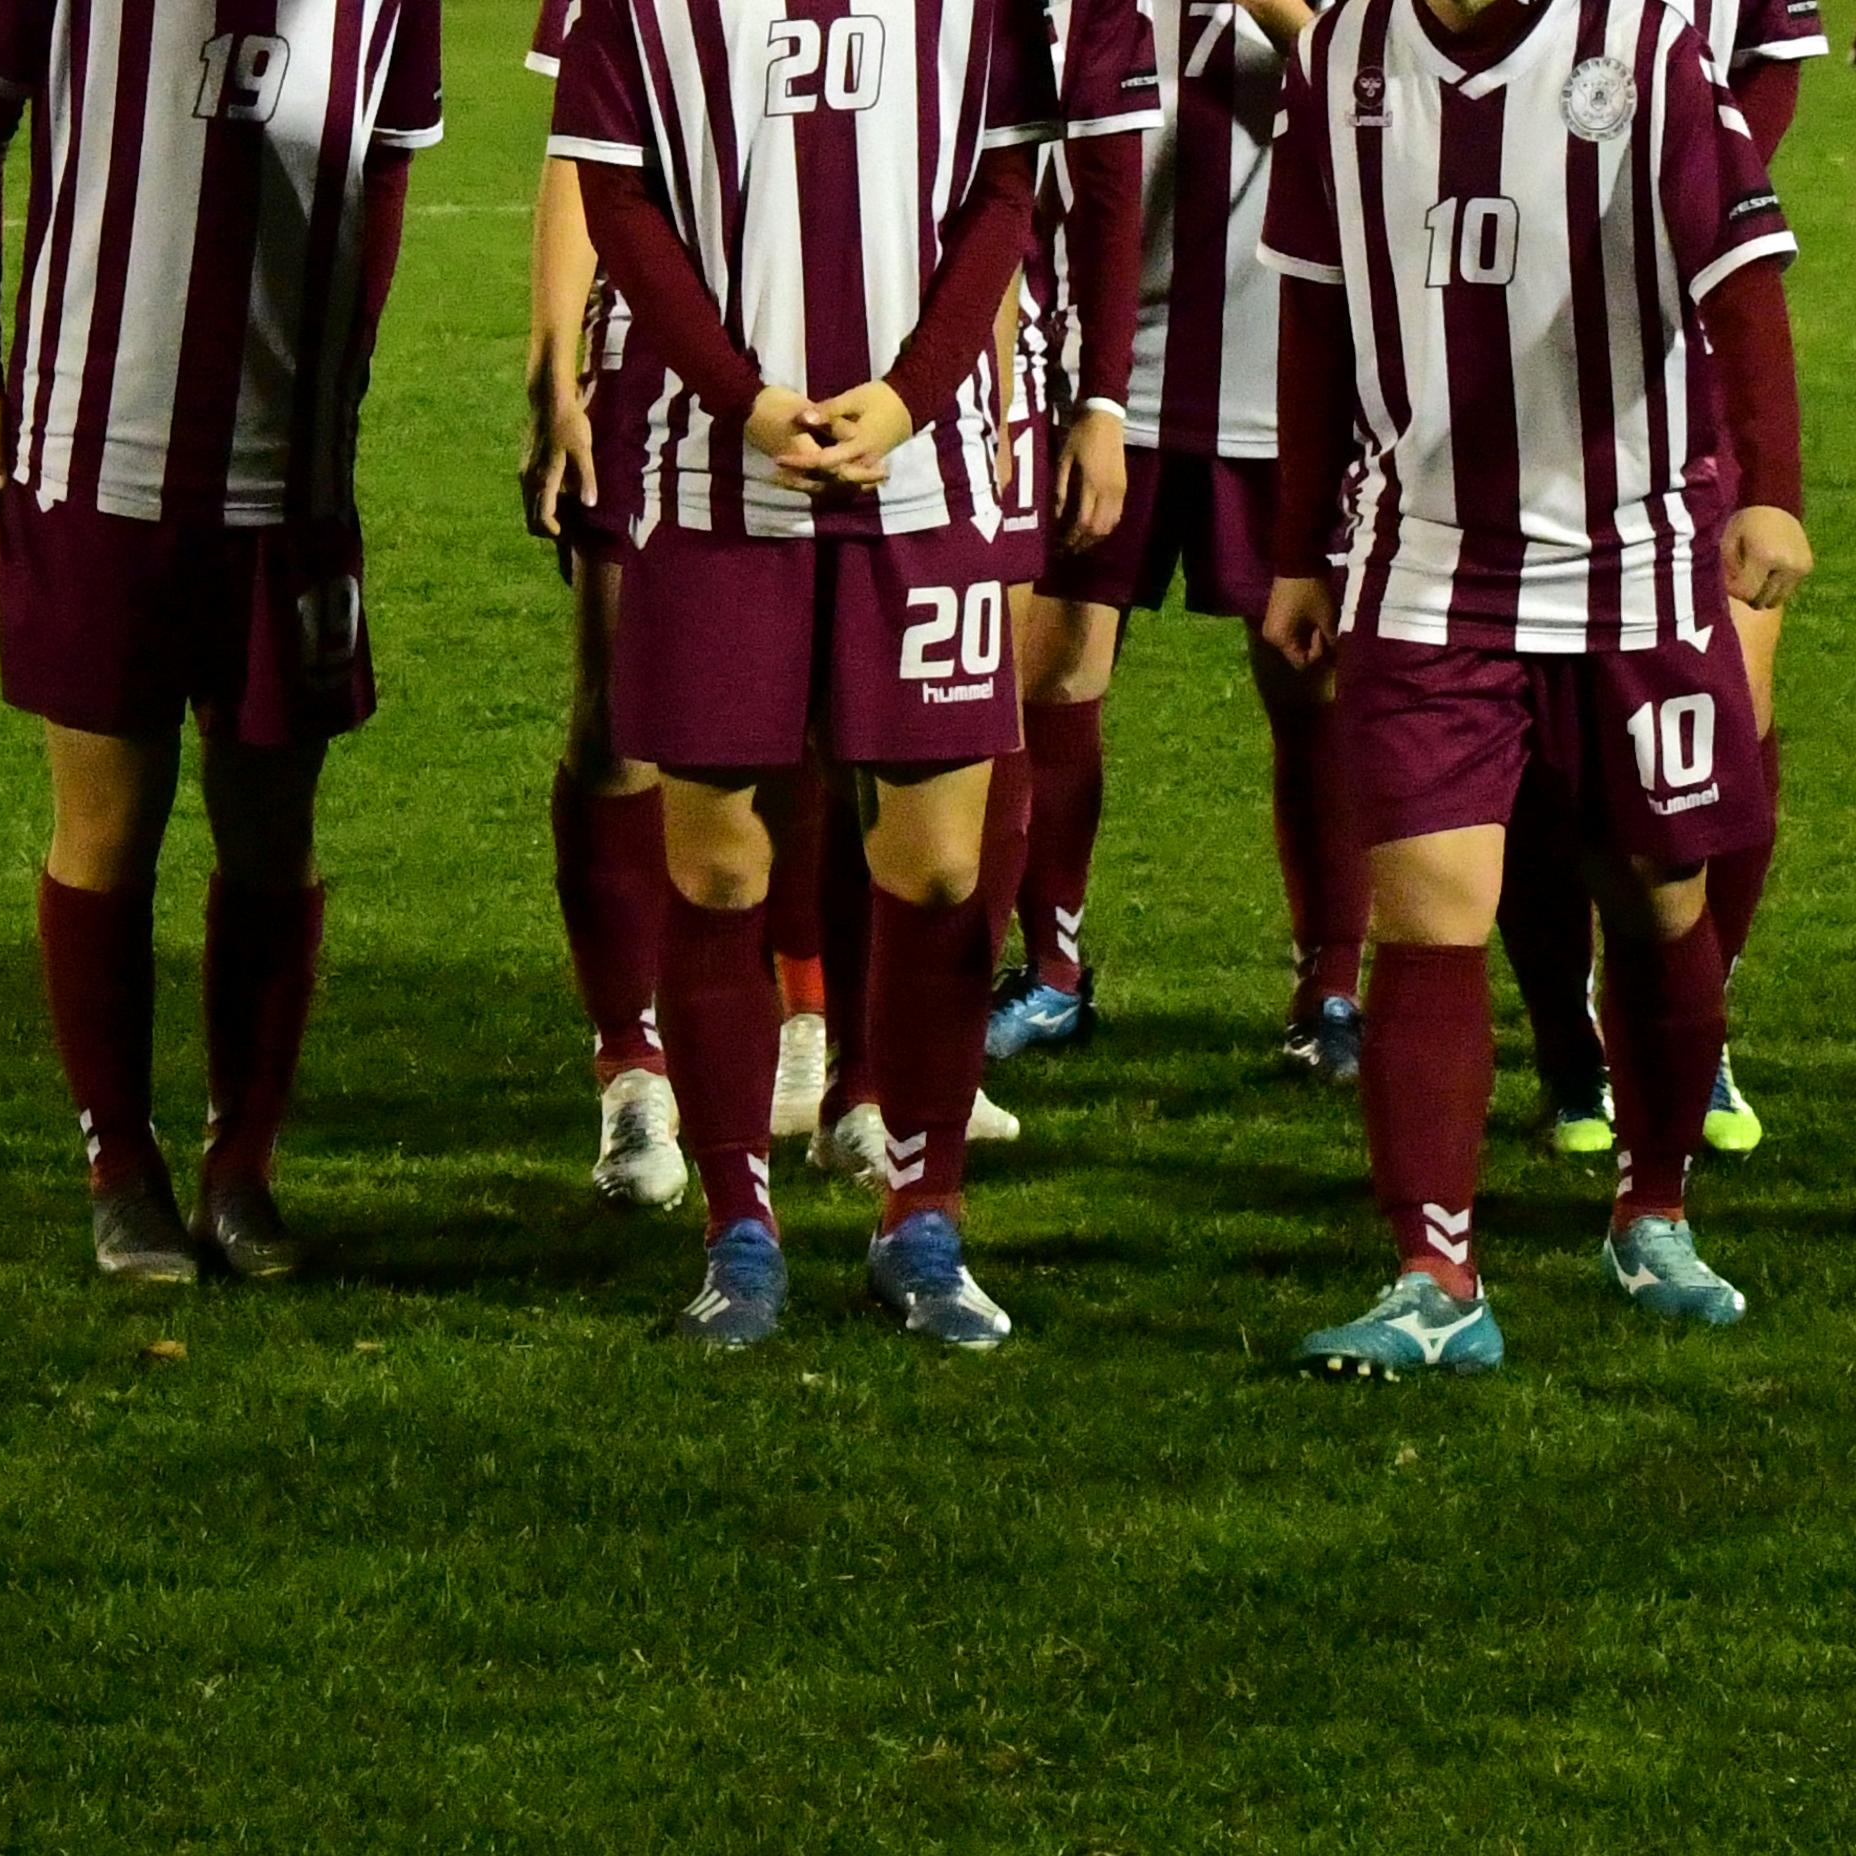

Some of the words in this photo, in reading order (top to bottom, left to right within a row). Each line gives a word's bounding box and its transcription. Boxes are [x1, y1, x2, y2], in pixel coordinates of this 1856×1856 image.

[192, 32, 290, 123] 19
[765, 14, 885, 117] 20
[1184, 1, 1236, 78] 7
[1425, 195, 1520, 288] 10
[899, 579, 1002, 680] 20
[923, 676, 994, 704] hummel
[1626, 692, 1716, 793] 10
